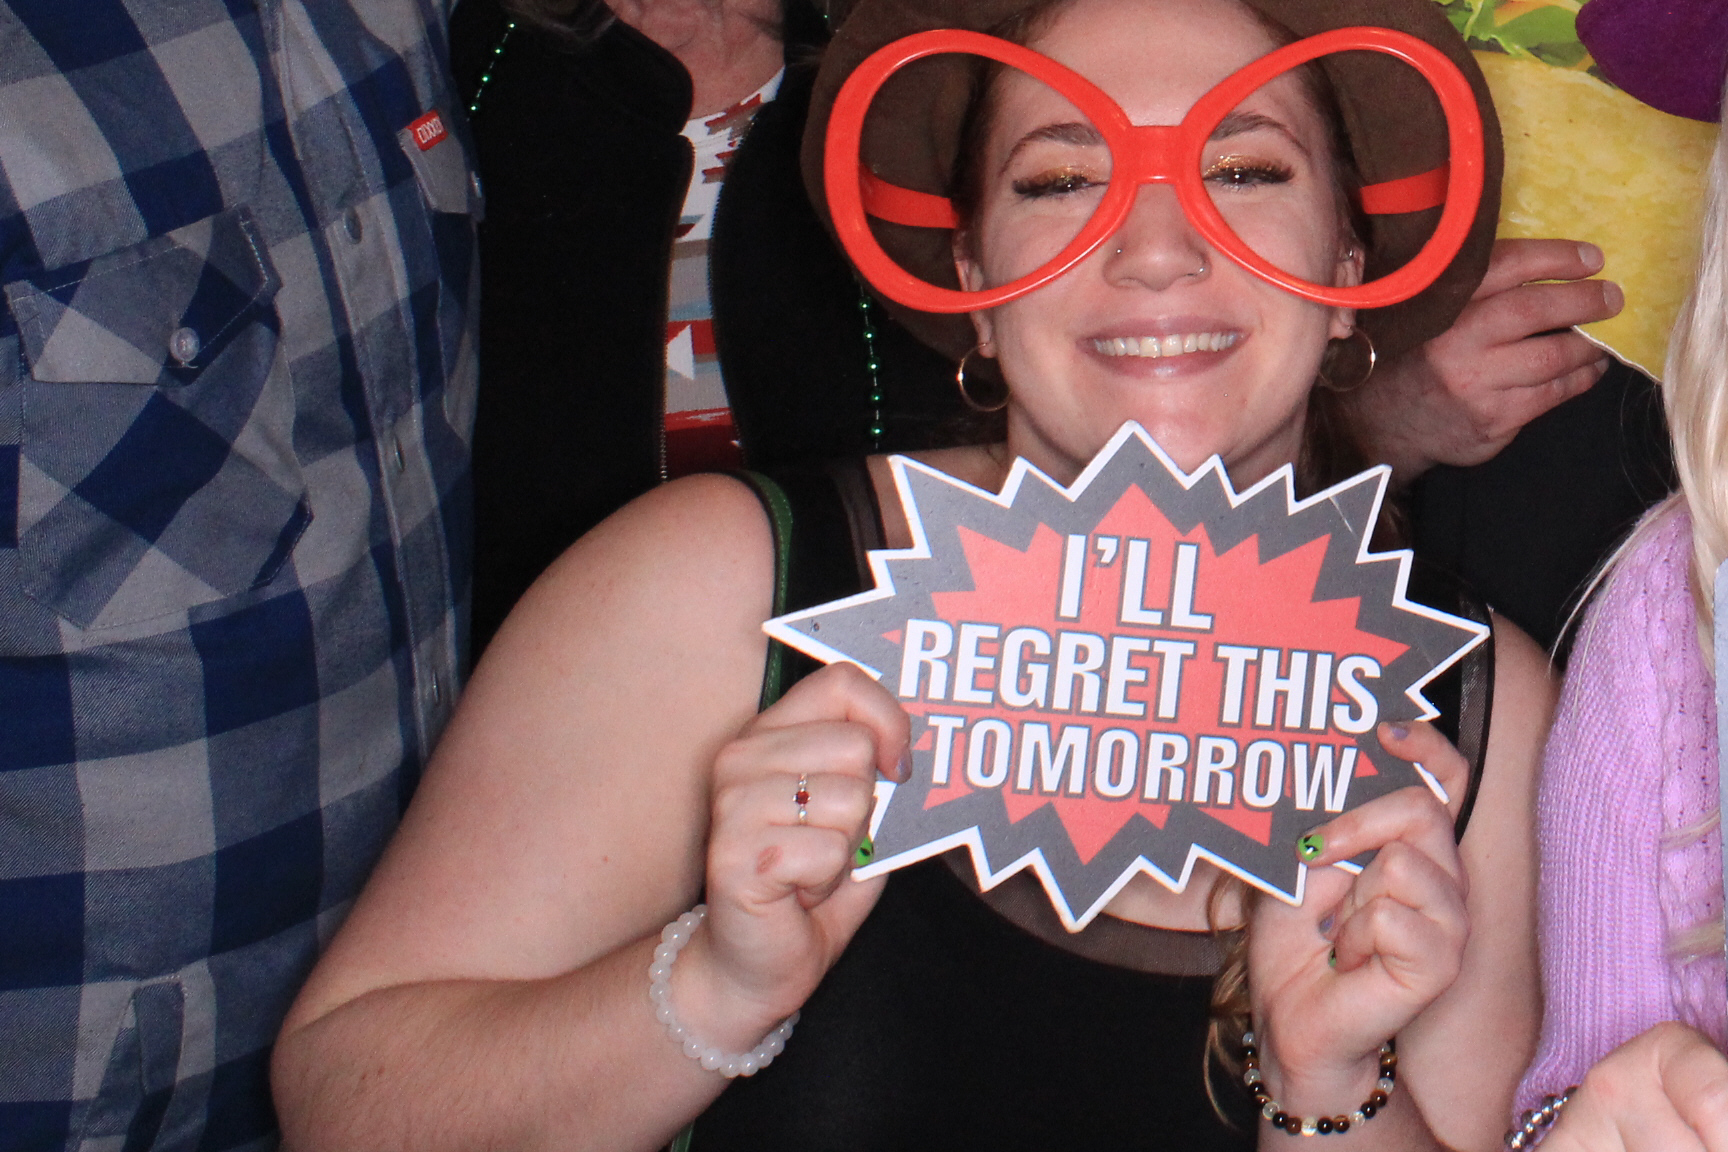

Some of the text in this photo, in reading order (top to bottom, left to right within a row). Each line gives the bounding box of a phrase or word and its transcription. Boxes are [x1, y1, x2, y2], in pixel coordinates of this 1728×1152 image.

[1058, 534, 1214, 631] I'LL
[899, 618, 1382, 734] REGRET THIS
[927, 714, 1358, 813] TOMORROW
